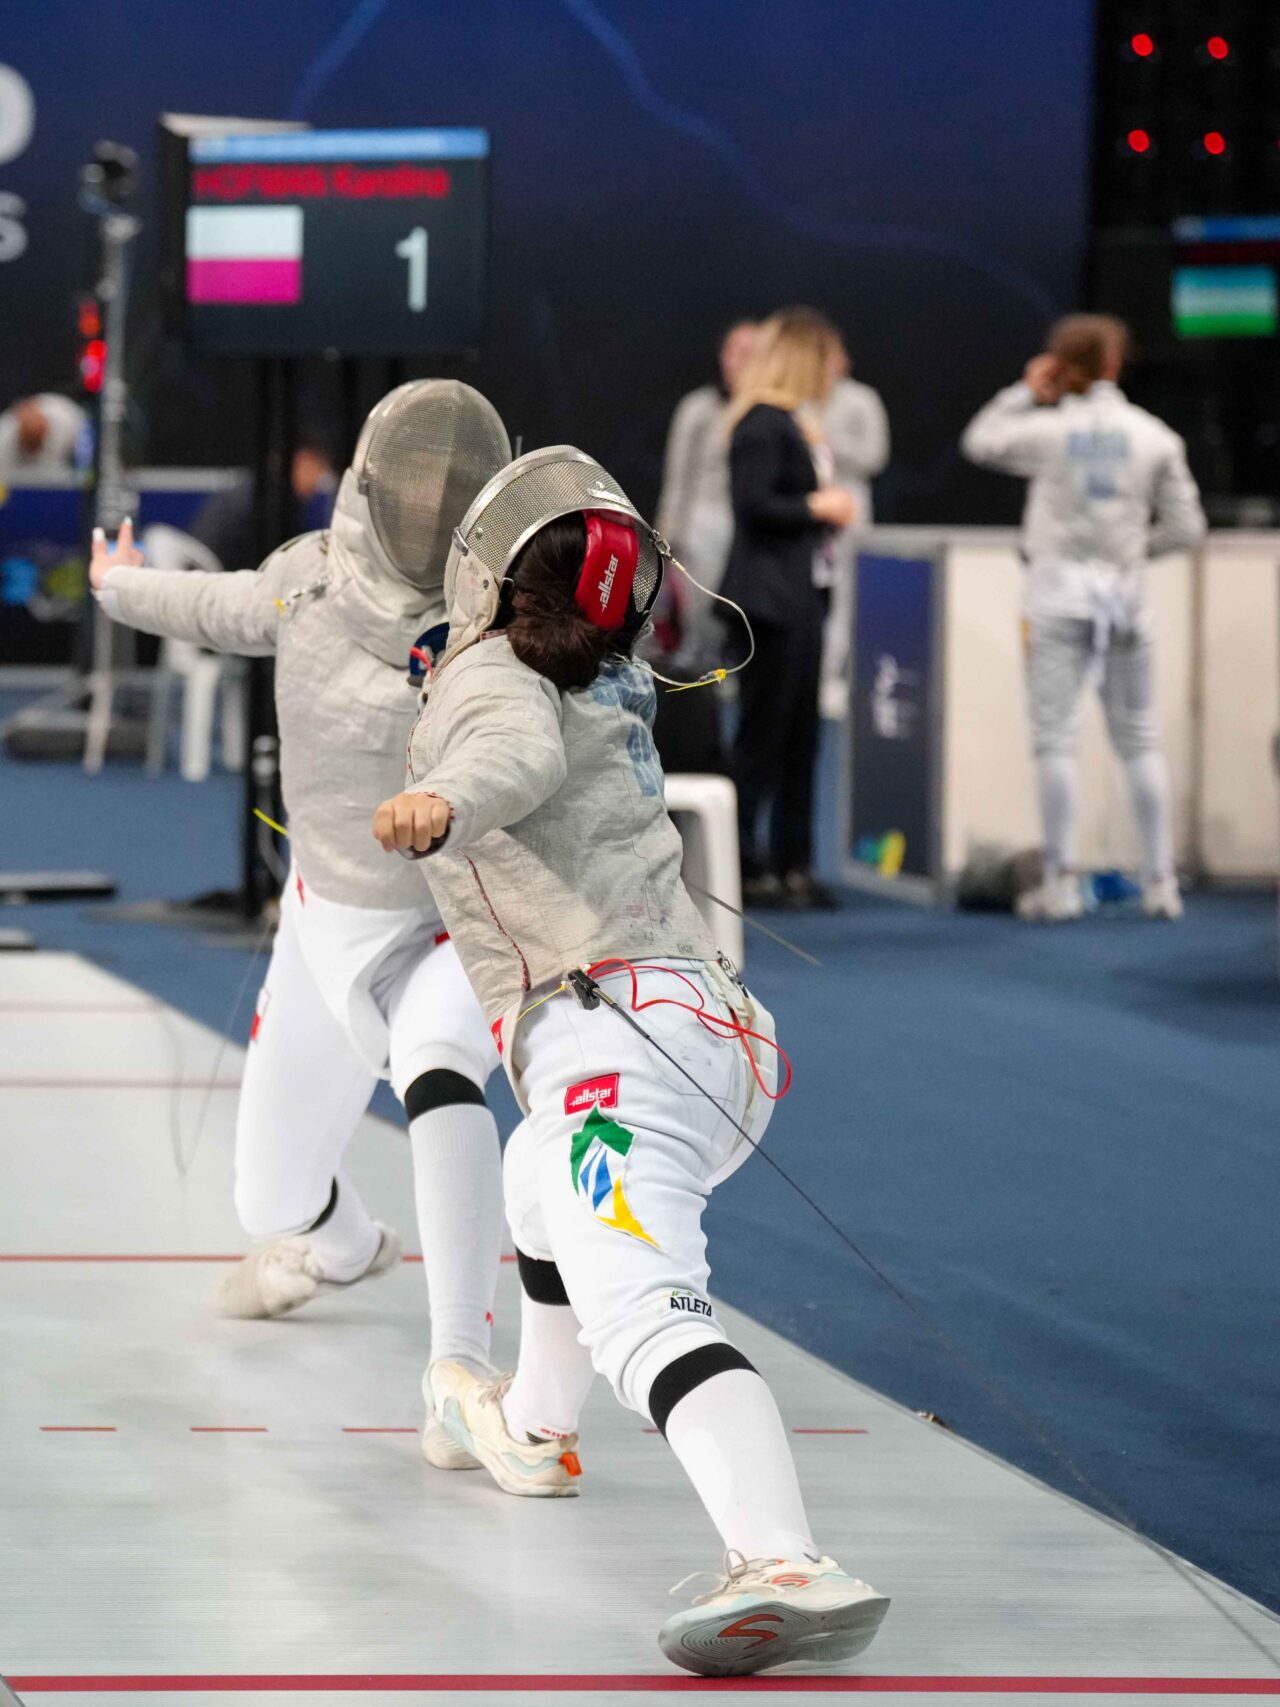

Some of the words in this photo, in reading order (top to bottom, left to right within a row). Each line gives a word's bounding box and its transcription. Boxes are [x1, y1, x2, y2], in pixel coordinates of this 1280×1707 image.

[395, 226, 429, 313] 1
[597, 553, 619, 608] allstar
[573, 1087, 613, 1105] allstar
[670, 1296, 712, 1317] ATLETA
